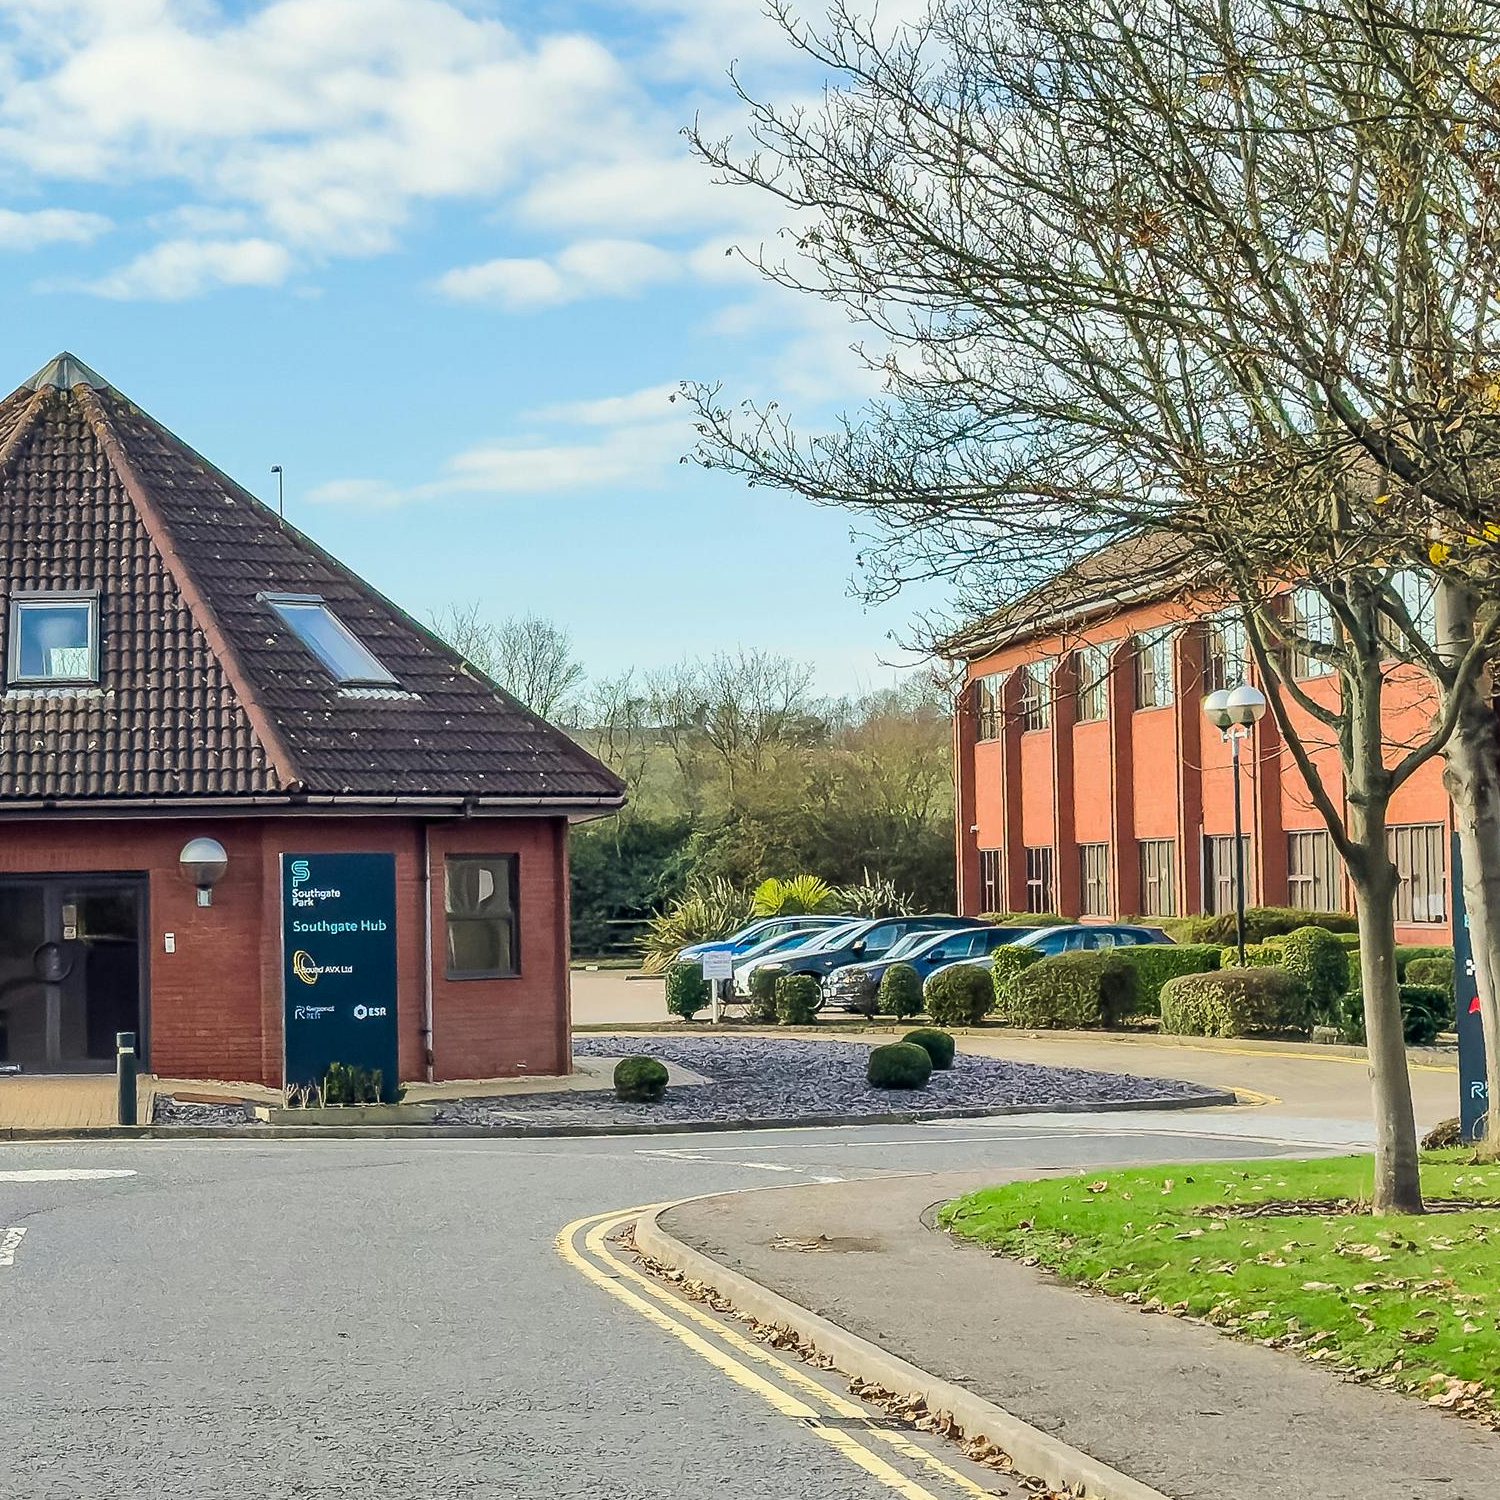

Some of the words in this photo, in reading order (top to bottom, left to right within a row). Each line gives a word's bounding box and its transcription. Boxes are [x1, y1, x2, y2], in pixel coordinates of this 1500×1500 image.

[292, 888, 341, 900] Southgate
[292, 898, 314, 907] Park
[293, 920, 358, 935] Southgate
[361, 919, 387, 931] Hub
[368, 1007, 387, 1016] ESR
